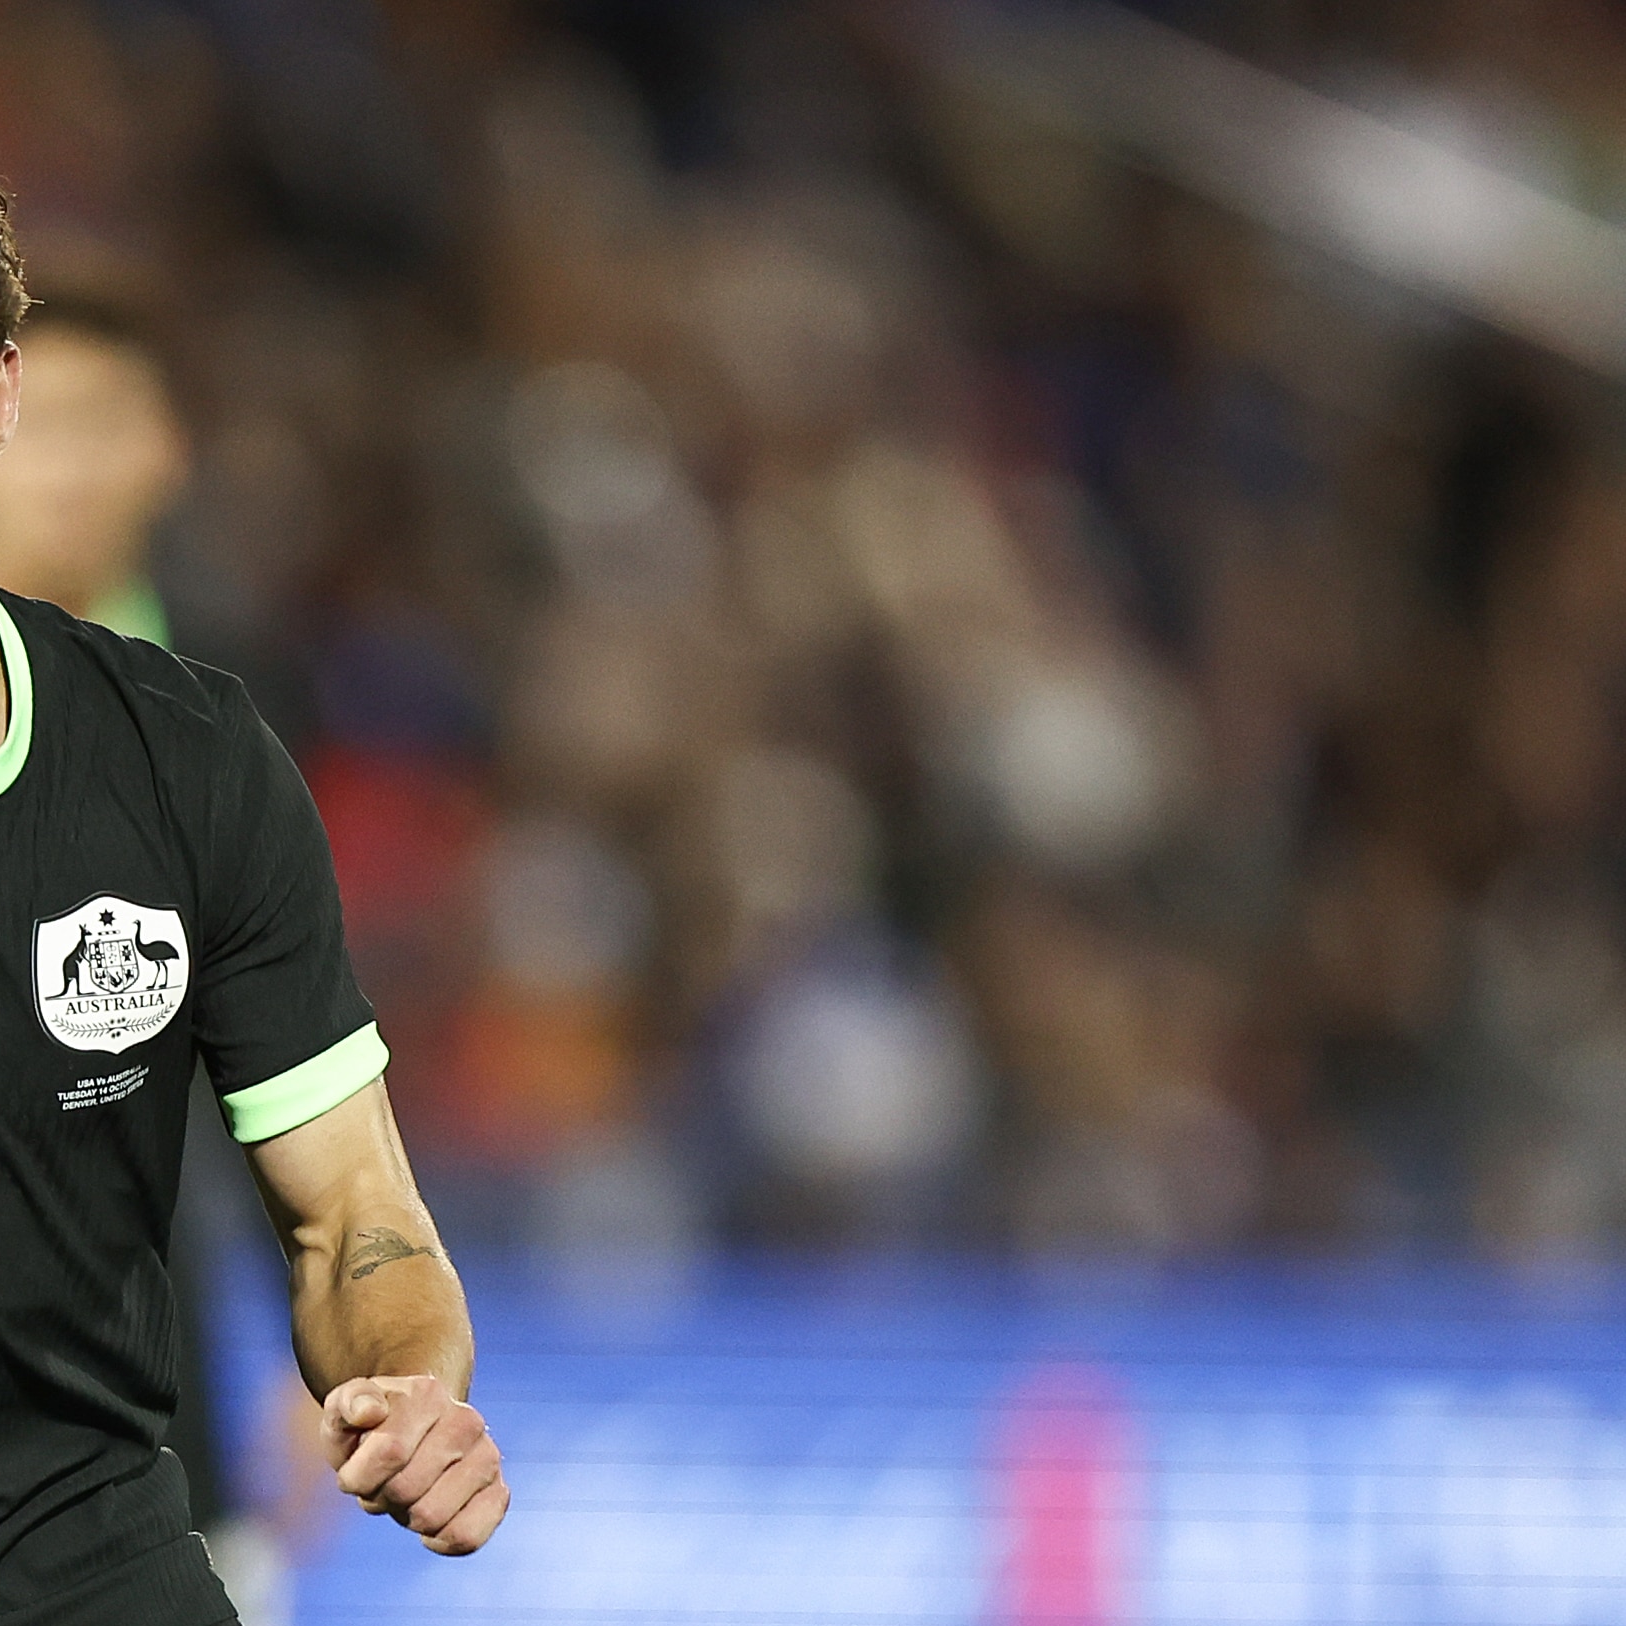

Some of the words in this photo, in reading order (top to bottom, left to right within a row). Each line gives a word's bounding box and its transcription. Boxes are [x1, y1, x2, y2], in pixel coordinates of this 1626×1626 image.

[66, 993, 164, 1015] AUSTRALIA
[77, 1078, 95, 1088] USA
[57, 1088, 97, 1101] TUESDAY
[99, 1086, 108, 1095] 14
